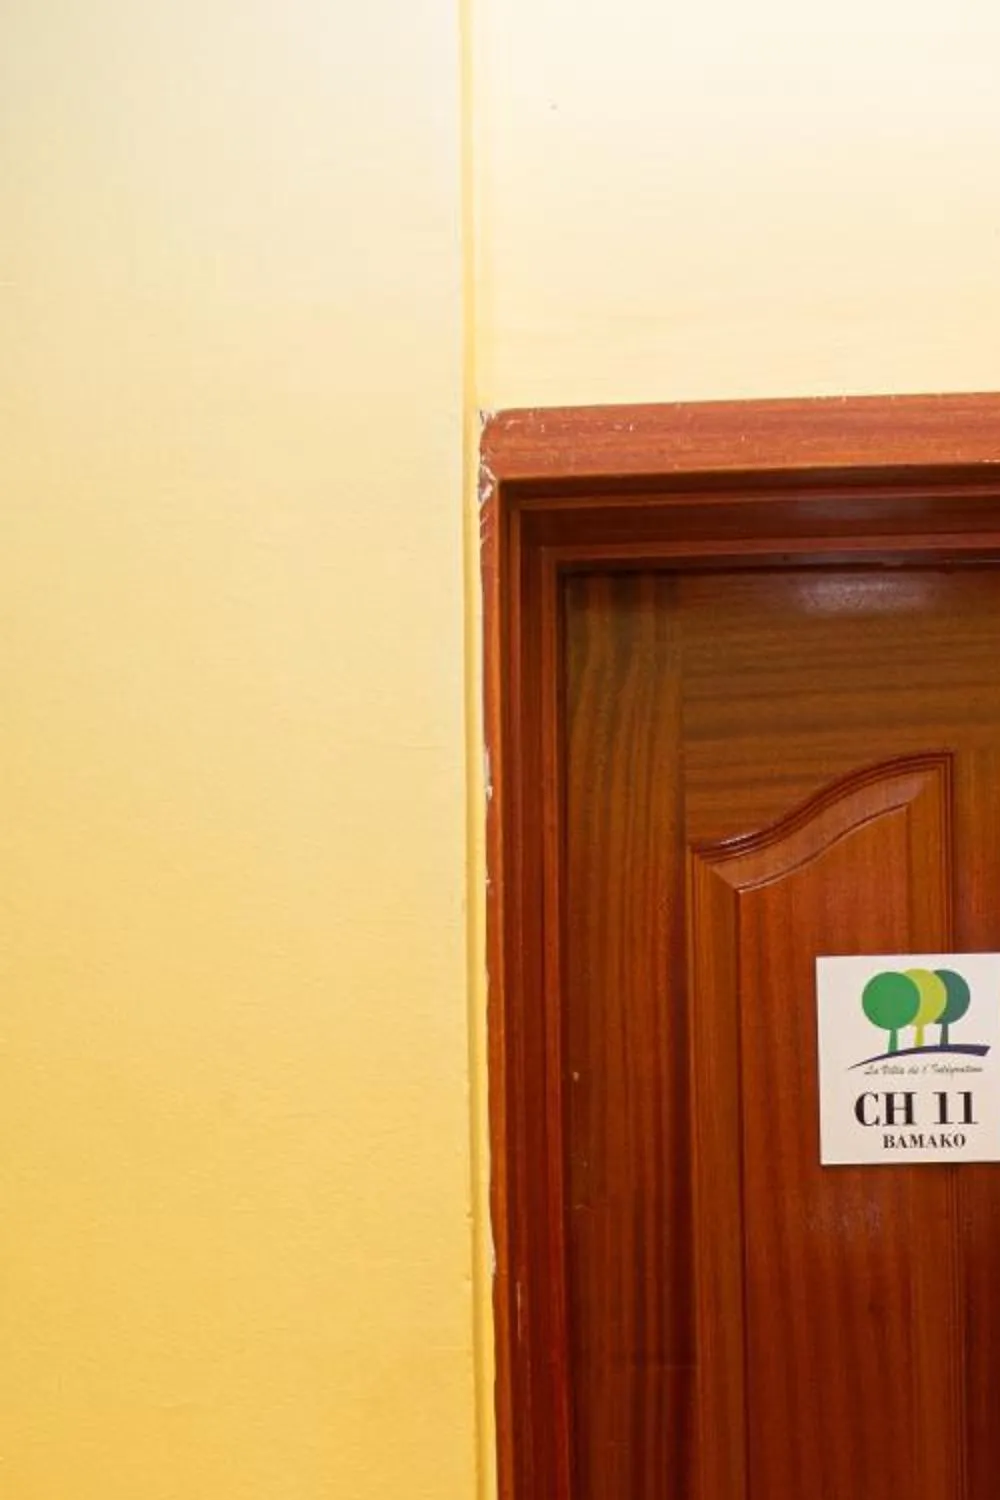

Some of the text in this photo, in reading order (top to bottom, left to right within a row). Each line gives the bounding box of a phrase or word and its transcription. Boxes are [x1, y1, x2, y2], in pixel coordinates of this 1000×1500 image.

[853, 1091, 980, 1127] CH 11
[882, 1133, 966, 1149] BAMAKO
